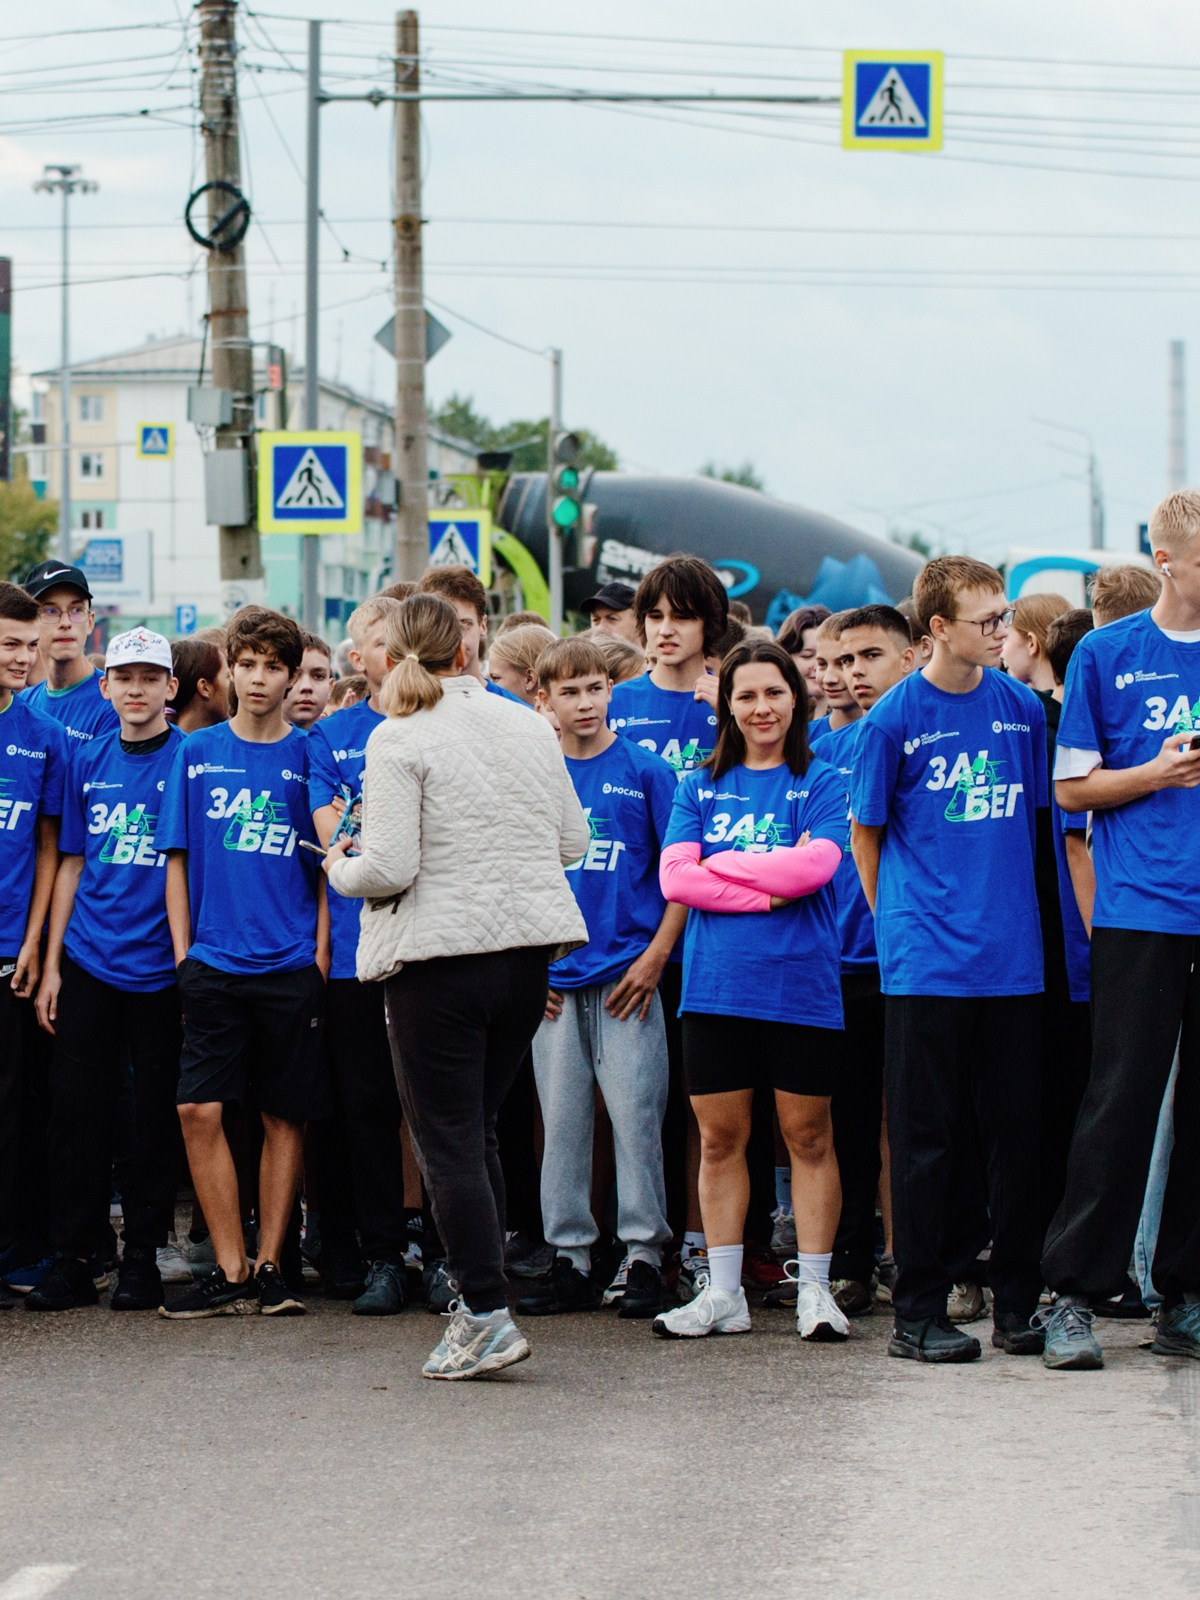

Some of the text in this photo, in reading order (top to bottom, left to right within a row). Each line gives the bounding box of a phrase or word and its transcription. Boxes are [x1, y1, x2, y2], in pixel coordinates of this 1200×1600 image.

[926, 750, 989, 791] ЗА!
[206, 787, 272, 820] ЗА!
[612, 787, 645, 799] РОСАТО
[964, 783, 1024, 822] БЕГ
[88, 803, 146, 834] ЗА!
[704, 813, 775, 843] ЗА!
[564, 839, 626, 871] ЕГ
